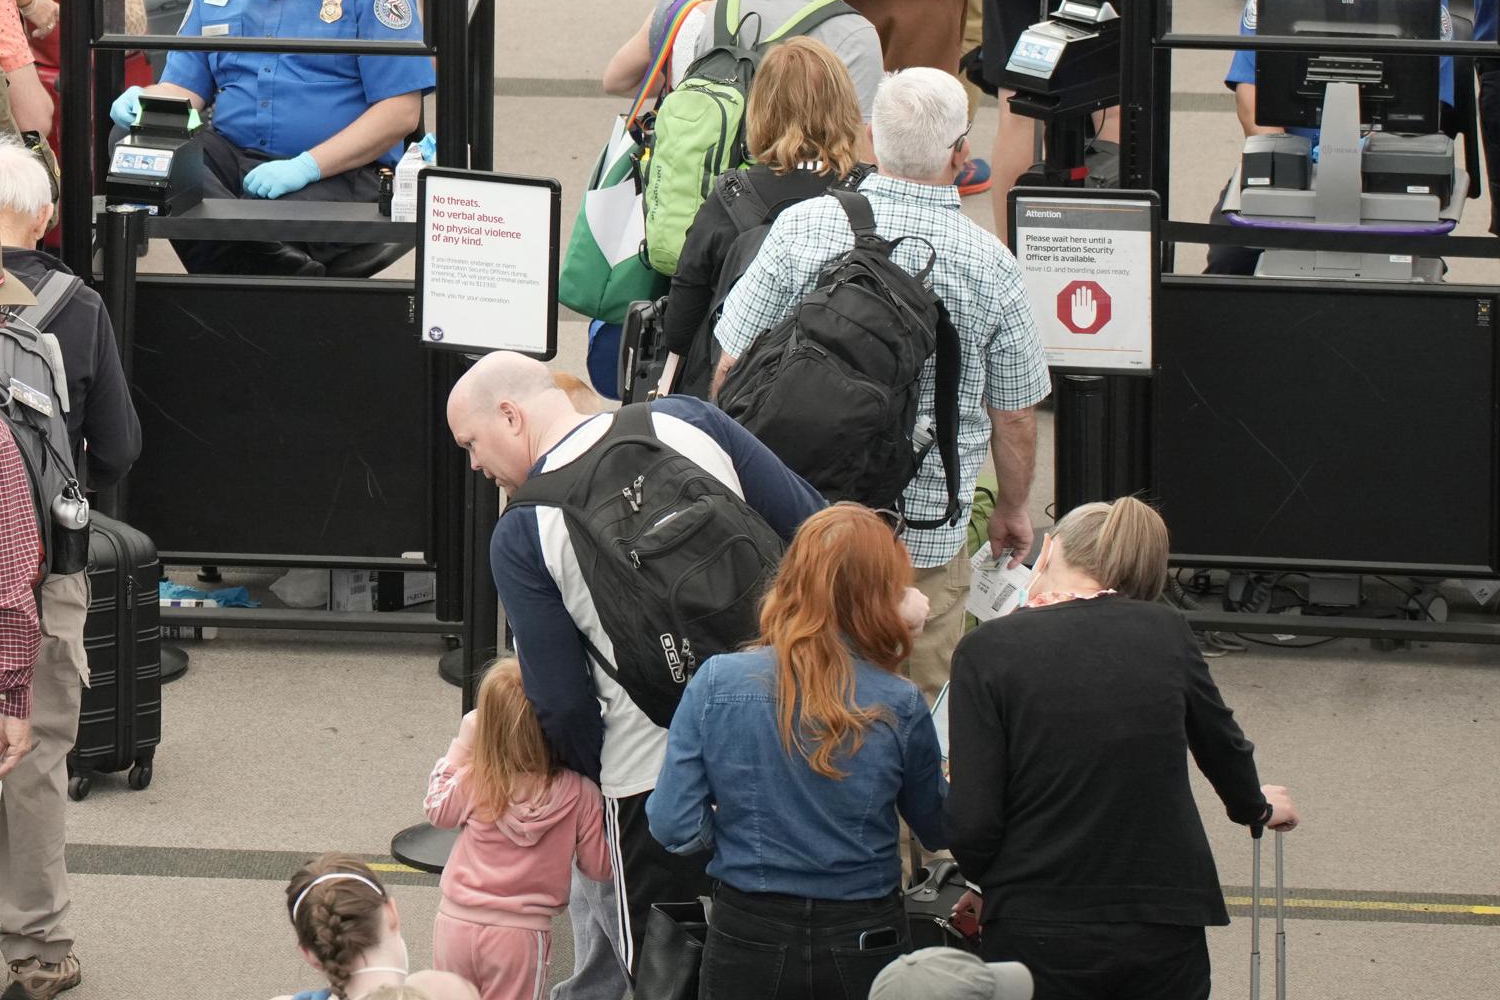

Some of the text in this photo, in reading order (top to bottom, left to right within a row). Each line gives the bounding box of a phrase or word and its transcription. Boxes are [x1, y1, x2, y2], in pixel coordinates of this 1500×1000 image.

[651, 164, 663, 221] patagonia
[432, 194, 481, 208] No threats.
[432, 209, 506, 224] No verbal abuse.
[1025, 210, 1062, 219] Attention
[432, 222, 522, 240] No physical violence
[432, 234, 484, 246] of any kind.
[1026, 234, 1050, 243] Please
[1052, 236, 1068, 244] wait
[1070, 236, 1087, 244] here
[1026, 244, 1114, 256] Transportation Security
[1026, 253, 1097, 264] Officer is available.
[432, 263, 468, 272] Transportation
[468, 266, 489, 274] Security
[490, 268, 510, 276] Officers
[1067, 267, 1096, 276] boarding
[660, 633, 685, 683] OGIO
